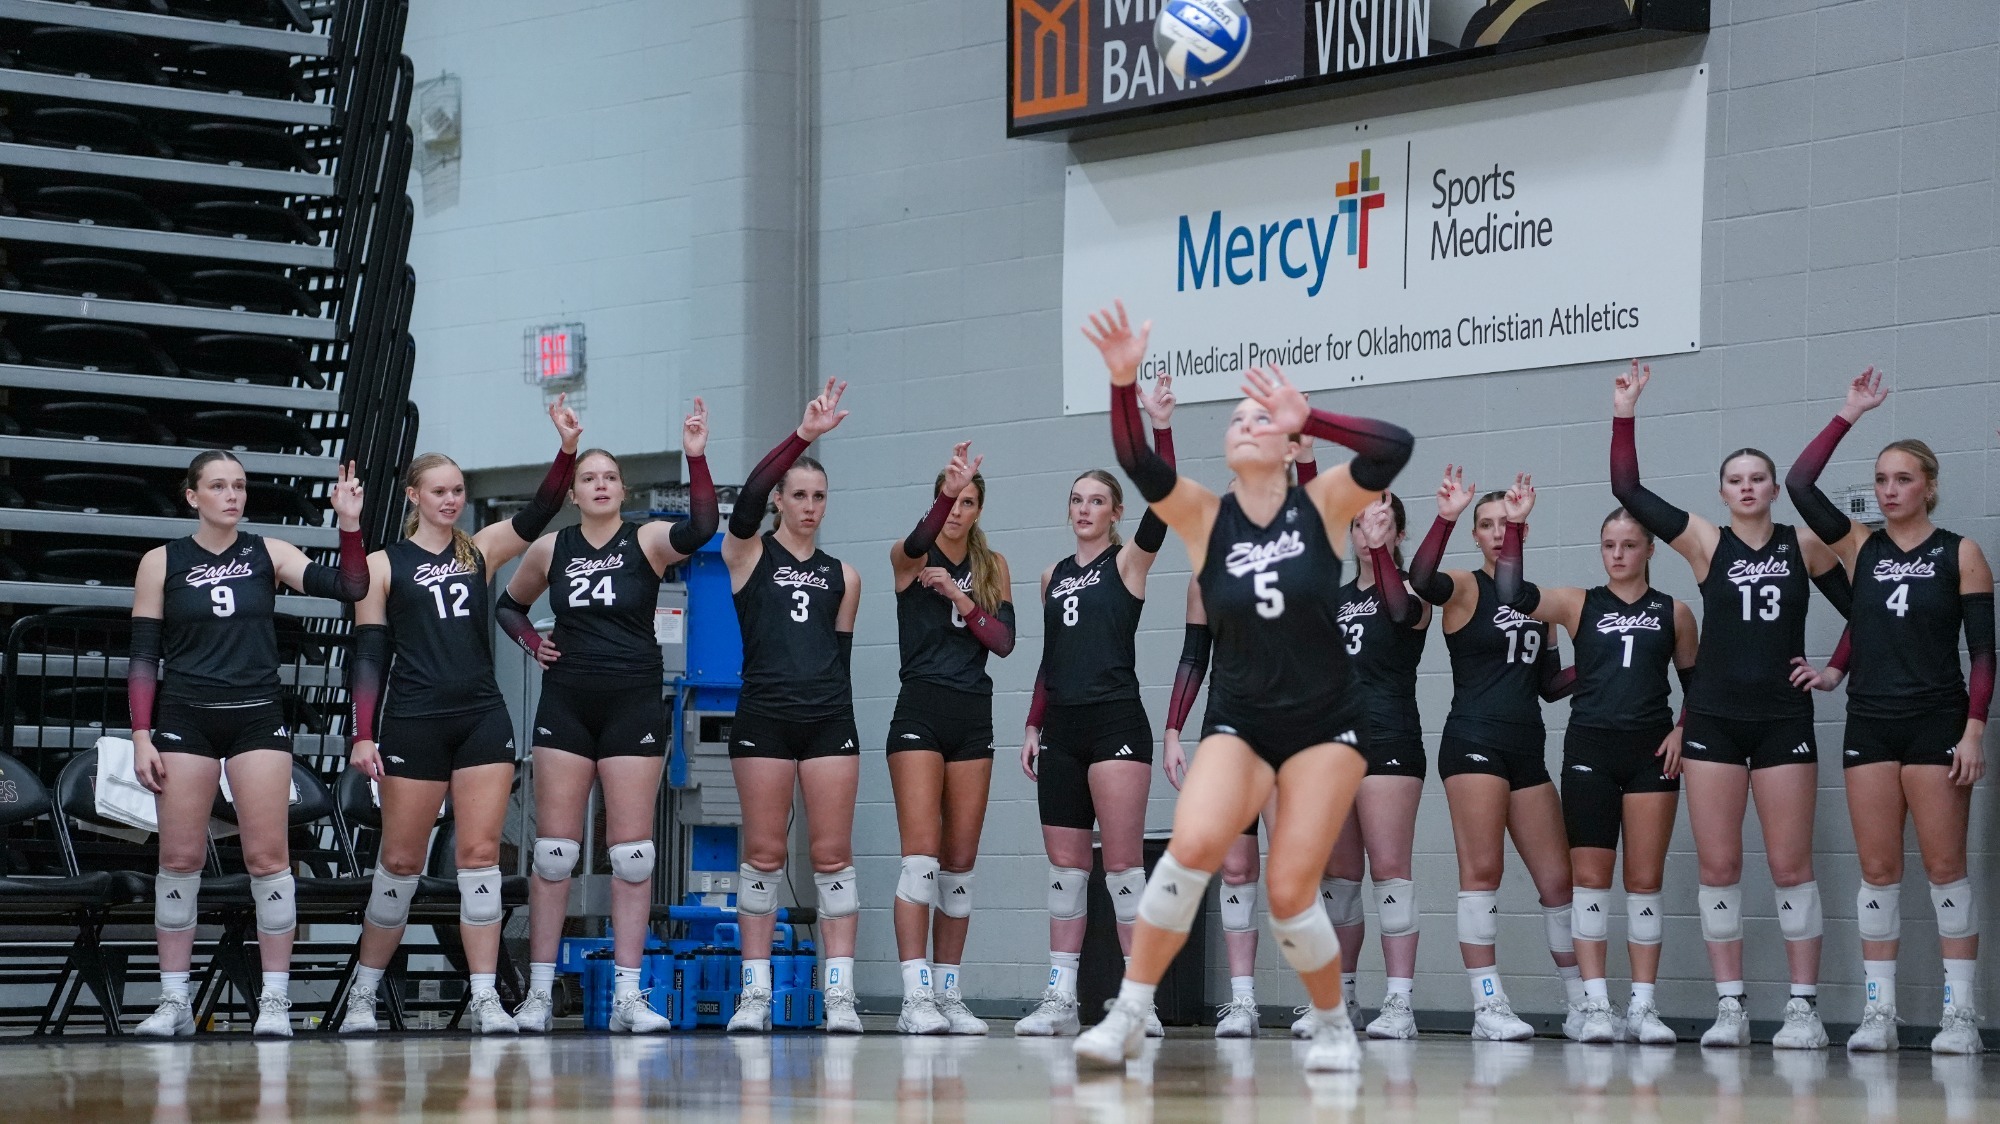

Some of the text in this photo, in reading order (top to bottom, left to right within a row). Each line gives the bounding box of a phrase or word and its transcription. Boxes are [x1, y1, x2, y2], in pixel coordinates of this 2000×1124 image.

[1314, 0, 1430, 76] VISION
[1102, 39, 1214, 104] BAN
[1431, 162, 1515, 217] Sports
[1430, 211, 1553, 261] Medicine
[1177, 209, 1339, 298] Mercy
[540, 334, 567, 376] EXIT
[1139, 301, 1639, 381] icial Medical Provider for Oklahoma Christian Athletics
[185, 557, 253, 588] Eagles
[564, 553, 624, 579] Eagles
[772, 565, 829, 590] Eagles
[1727, 555, 1791, 585] Eagles
[1873, 556, 1936, 582] Eagles
[210, 586, 235, 618] 9
[428, 582, 470, 619] 12
[568, 575, 616, 608] 24
[790, 590, 810, 623] 3
[1253, 571, 1285, 620] 5
[1738, 584, 1781, 621] 13
[1885, 583, 1909, 617] 4
[1062, 595, 1079, 627] 8
[1596, 611, 1662, 634] Eagles
[1505, 629, 1541, 664] 19
[1621, 634, 1635, 668] 1
[696, 1003, 719, 1013] ERADE
